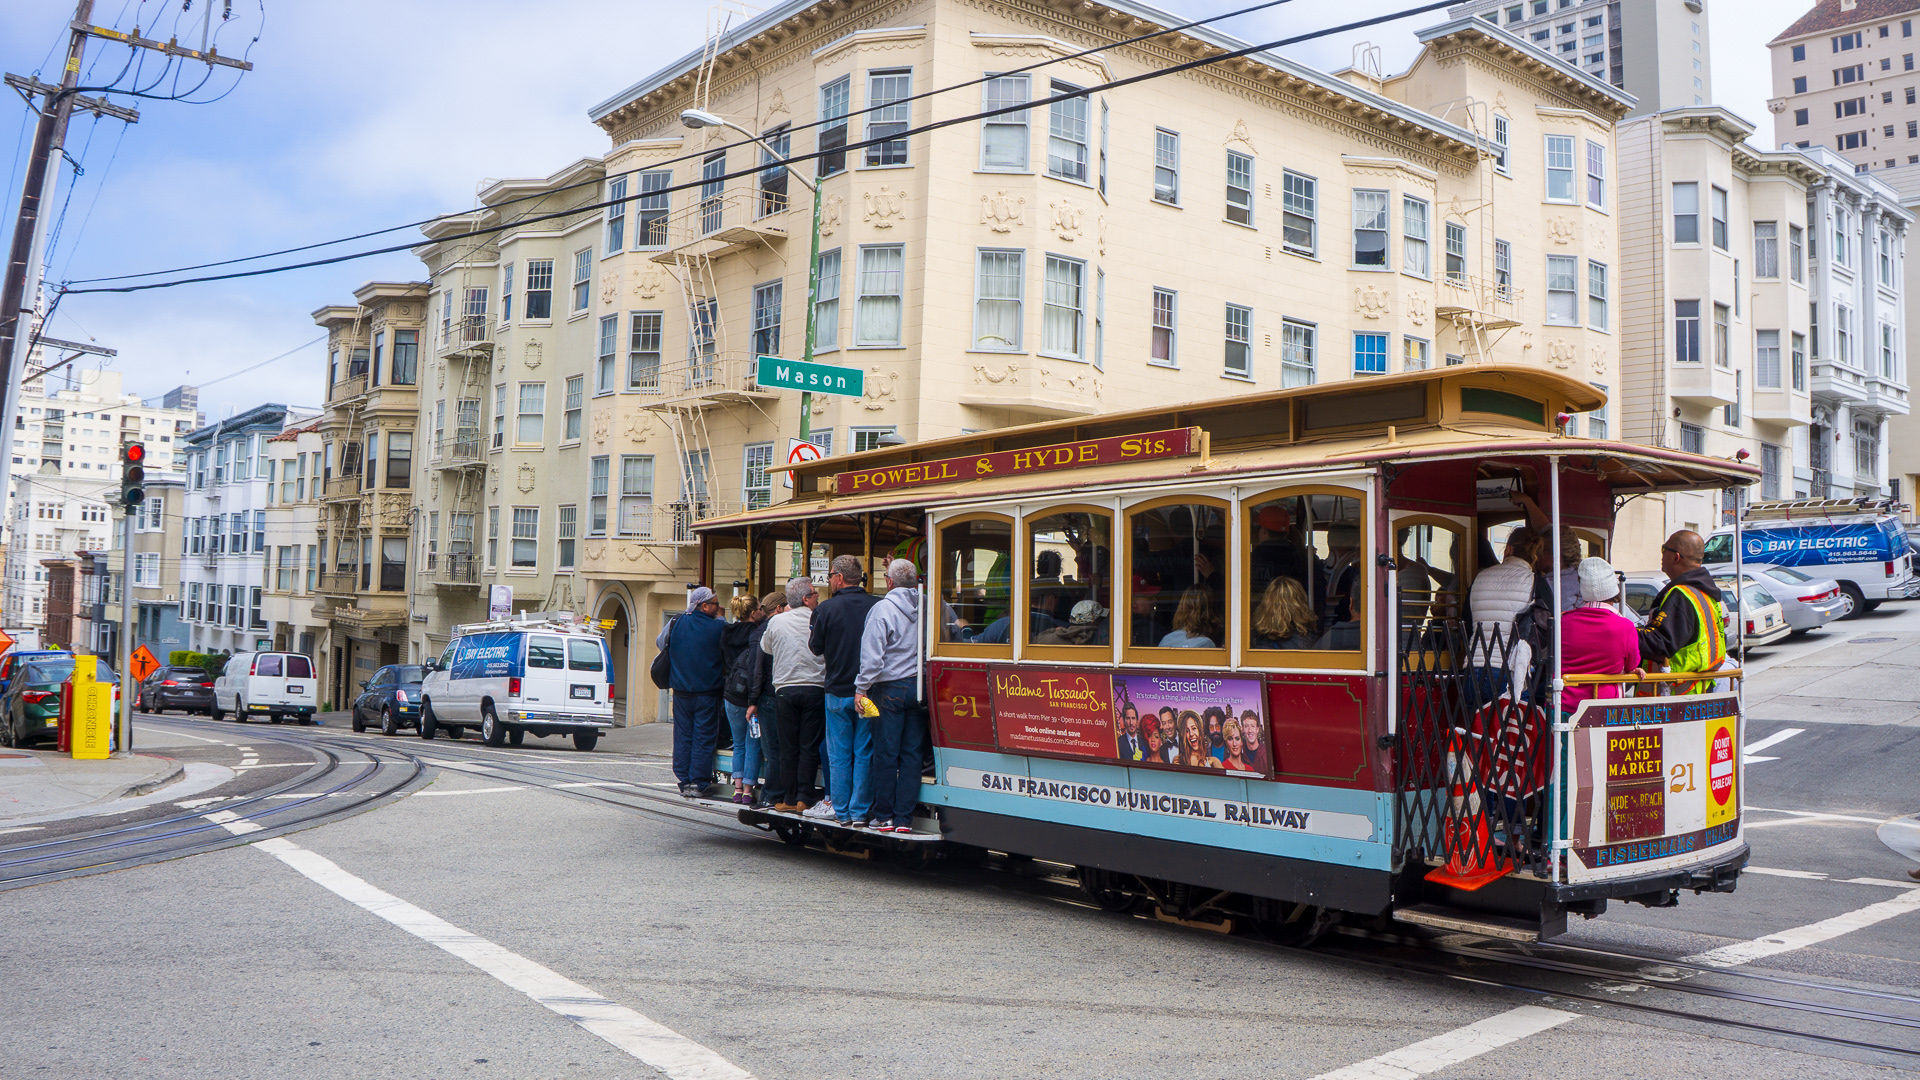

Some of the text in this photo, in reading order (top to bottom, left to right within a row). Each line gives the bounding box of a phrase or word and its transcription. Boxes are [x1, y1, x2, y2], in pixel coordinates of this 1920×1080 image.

[776, 366, 846, 388] Mason
[852, 437, 1172, 489] POWELL & HYDE Sts.
[1768, 536, 1869, 552] BAY ELECTRIC
[464, 646, 510, 660] BAY ELECTRIC
[996, 674, 1100, 712] Madame Tussauds
[1196, 696, 1218, 704] happens
[952, 695, 981, 718] 21
[1060, 702, 1088, 710] FRANCISCO
[1606, 706, 1672, 725] MARKET
[1684, 701, 1725, 720] STREET
[84, 686, 98, 749] CHRONICLE
[1061, 716, 1075, 724] Open
[1094, 718, 1108, 728] daily
[1025, 726, 1038, 734] Book
[1039, 727, 1056, 735] online
[1010, 733, 1100, 748] madametussauds.com/SanFrancisco
[1610, 736, 1661, 752] POWELL
[1714, 736, 1731, 750] DO NOT
[1624, 750, 1650, 762] AND
[1717, 748, 1728, 760] PASS
[1609, 760, 1662, 776] MARKET
[1670, 763, 1697, 794] 21
[1712, 778, 1725, 791] CABLE
[982, 773, 1311, 830] SAN FRANCISCO MUNICIPAL RAILWAY
[1610, 795, 1629, 810] HYDE
[1640, 792, 1663, 808] BEACH
[1596, 834, 1695, 866] FISHERMANS
